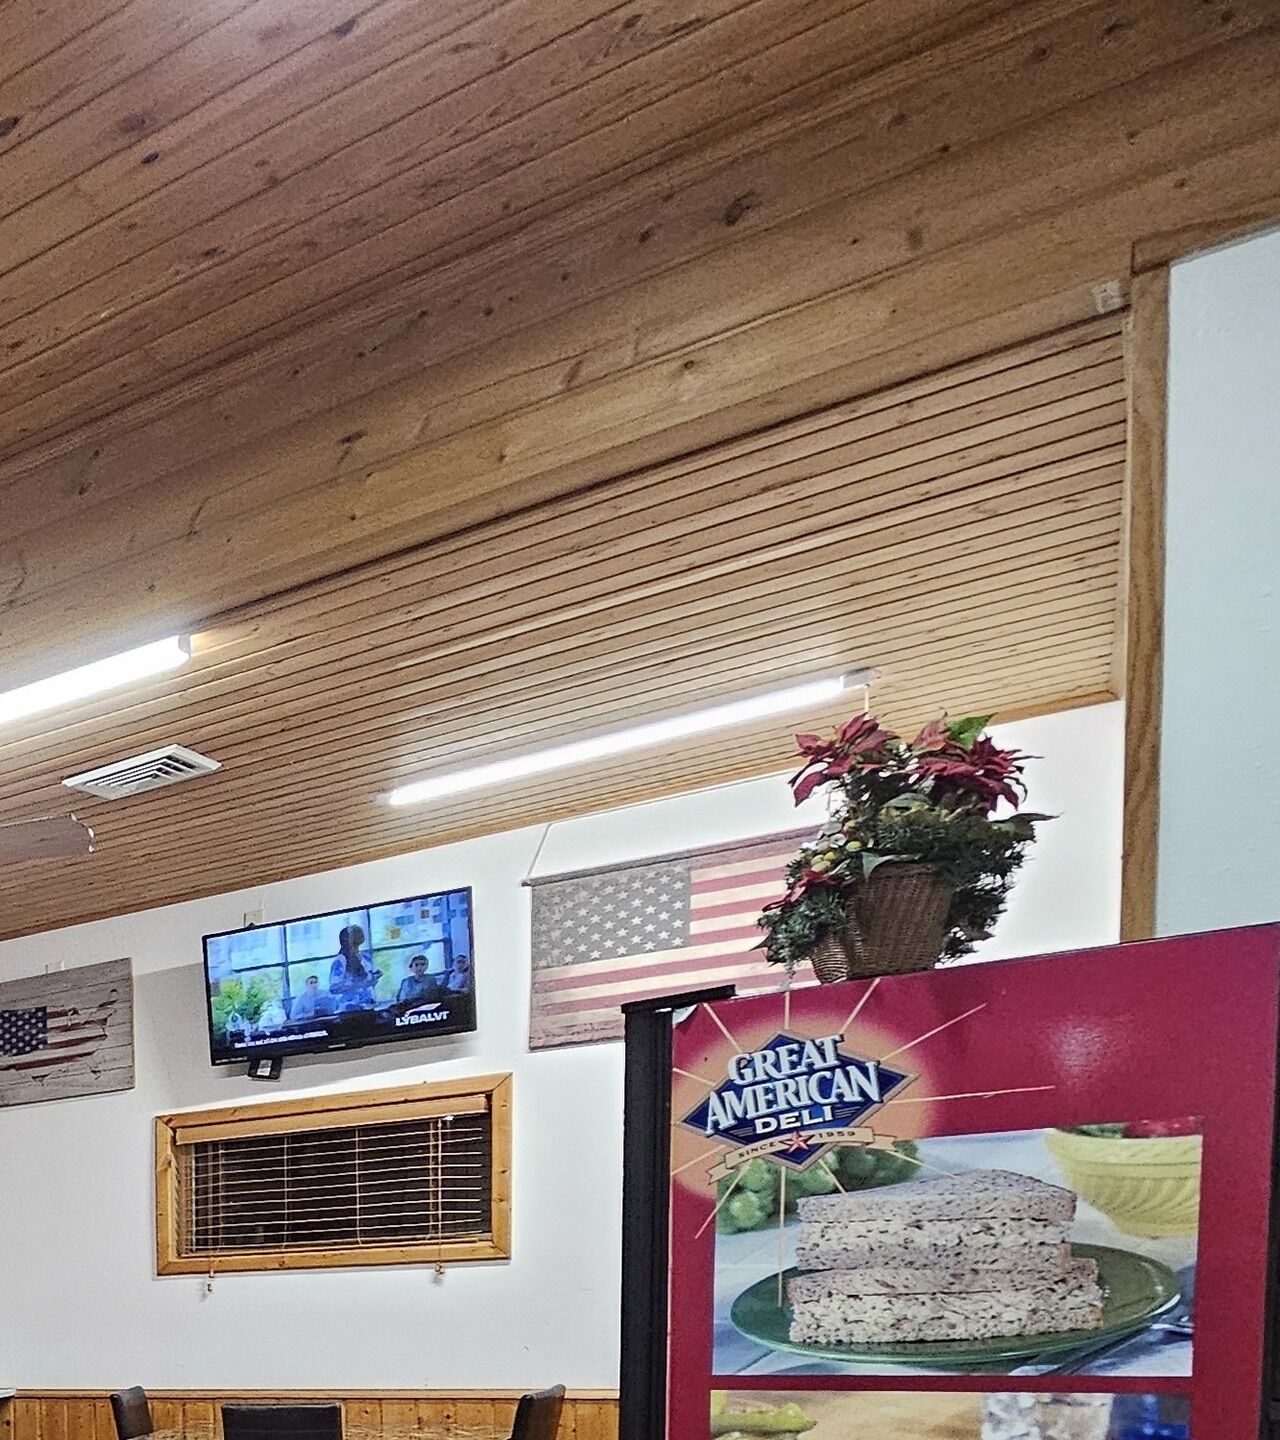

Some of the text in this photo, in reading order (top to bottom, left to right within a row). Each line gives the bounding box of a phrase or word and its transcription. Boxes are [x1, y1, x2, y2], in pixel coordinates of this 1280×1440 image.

[727, 1034, 846, 1086] GREAT
[705, 1061, 884, 1135] AMERICAN
[755, 1105, 834, 1134] DELI
[737, 1129, 856, 1158] SINCE 1959
